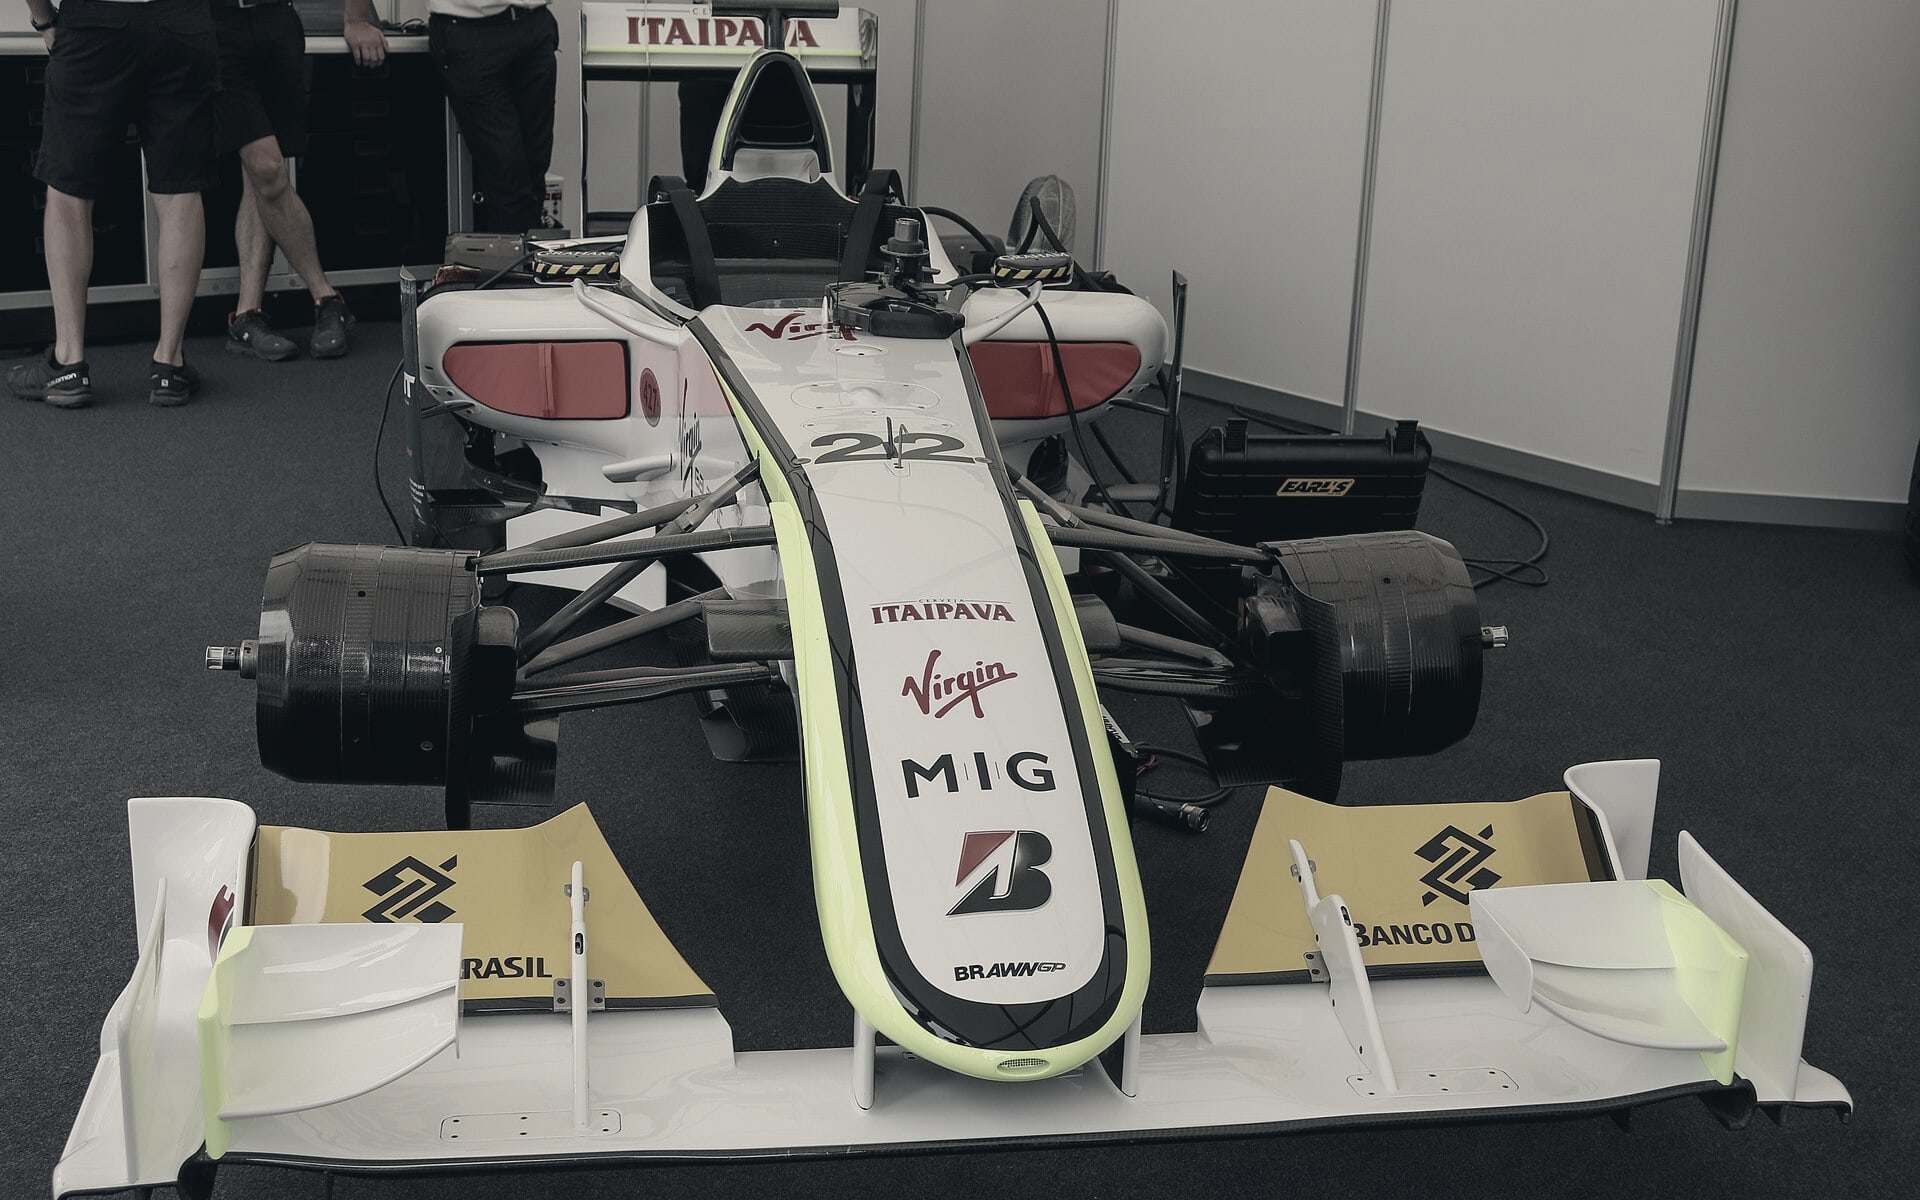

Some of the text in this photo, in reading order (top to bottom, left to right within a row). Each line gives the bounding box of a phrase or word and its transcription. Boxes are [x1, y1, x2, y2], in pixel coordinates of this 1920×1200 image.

[1280, 480, 1354, 493] EARL'S
[871, 603, 1016, 625] ITAIPAVA
[901, 649, 1018, 719] Virgin
[459, 956, 553, 980] RASIL
